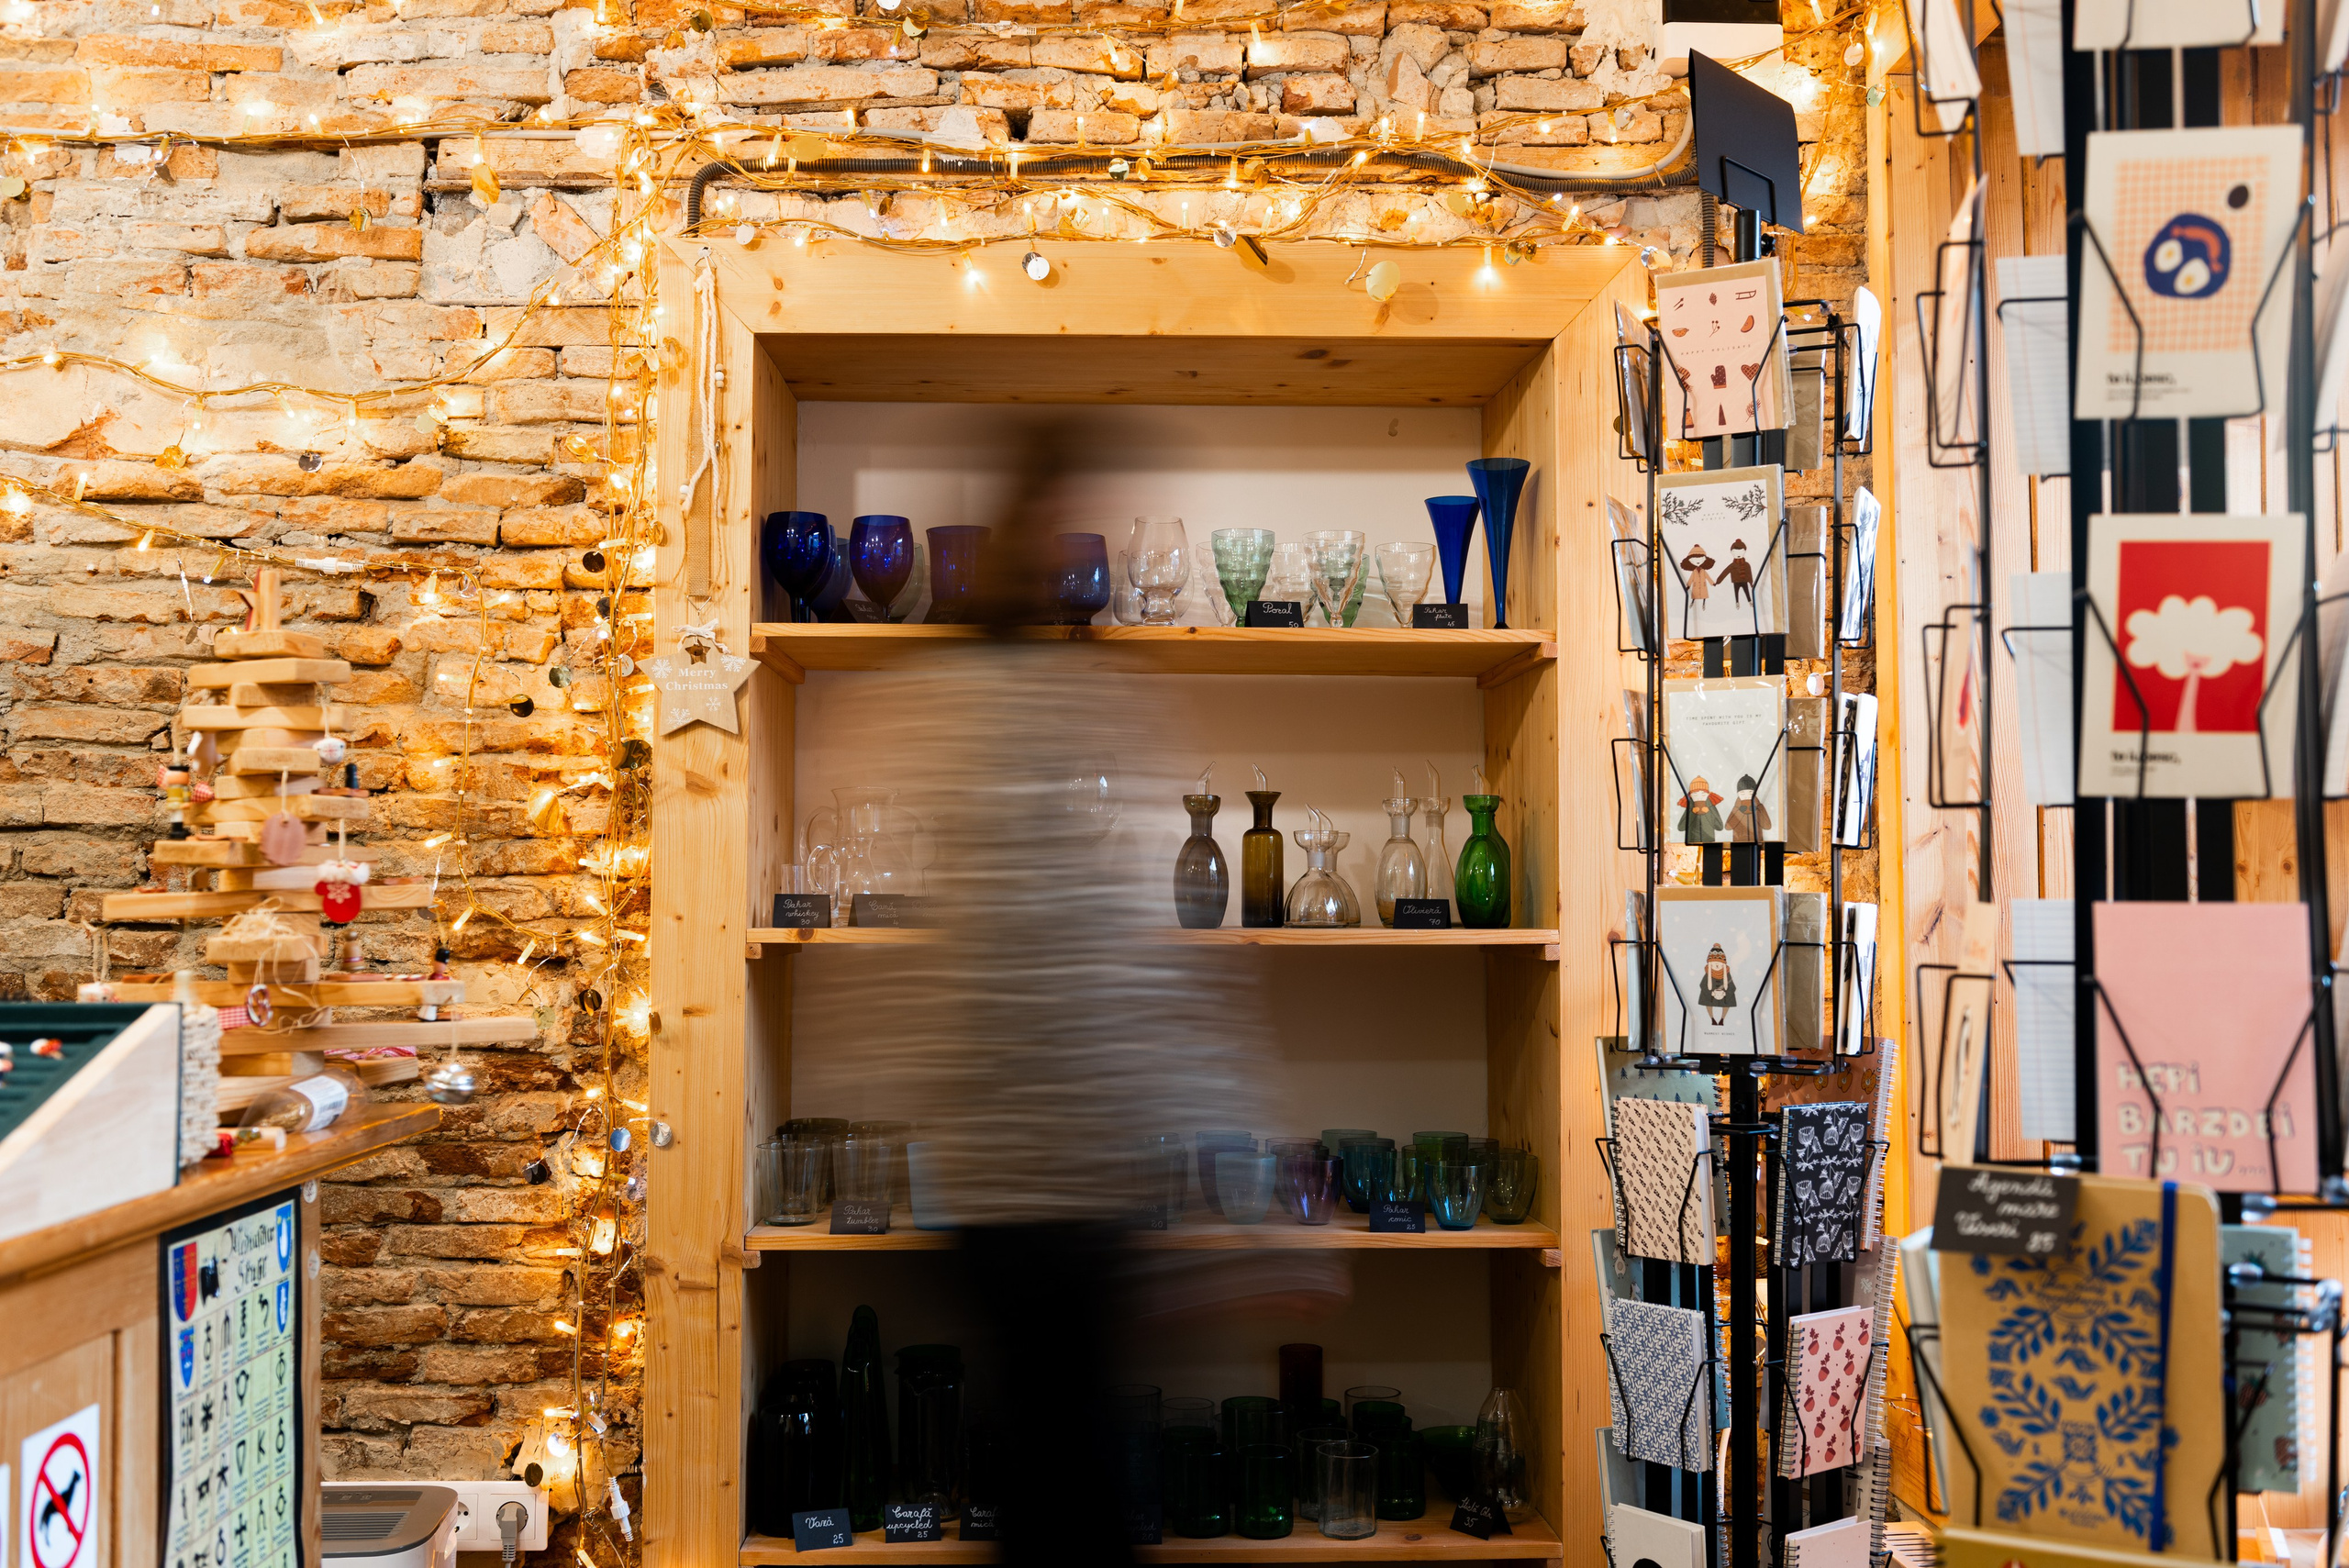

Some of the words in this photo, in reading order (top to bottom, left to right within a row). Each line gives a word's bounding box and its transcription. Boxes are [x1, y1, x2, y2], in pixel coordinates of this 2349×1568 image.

[678, 668, 717, 678] Merry
[665, 681, 729, 691] Christmas
[783, 899, 812, 908] Pahar
[785, 908, 820, 921] whiskey
[843, 1205, 871, 1216] Pahar
[1383, 1204, 1409, 1214] Pahar
[892, 1506, 933, 1521] Carafă
[805, 1516, 834, 1529] Vază
[885, 1518, 933, 1535] upcycled
[1464, 1517, 1479, 1528] 35
[833, 1533, 844, 1545] 25
[918, 1530, 928, 1539] 25
